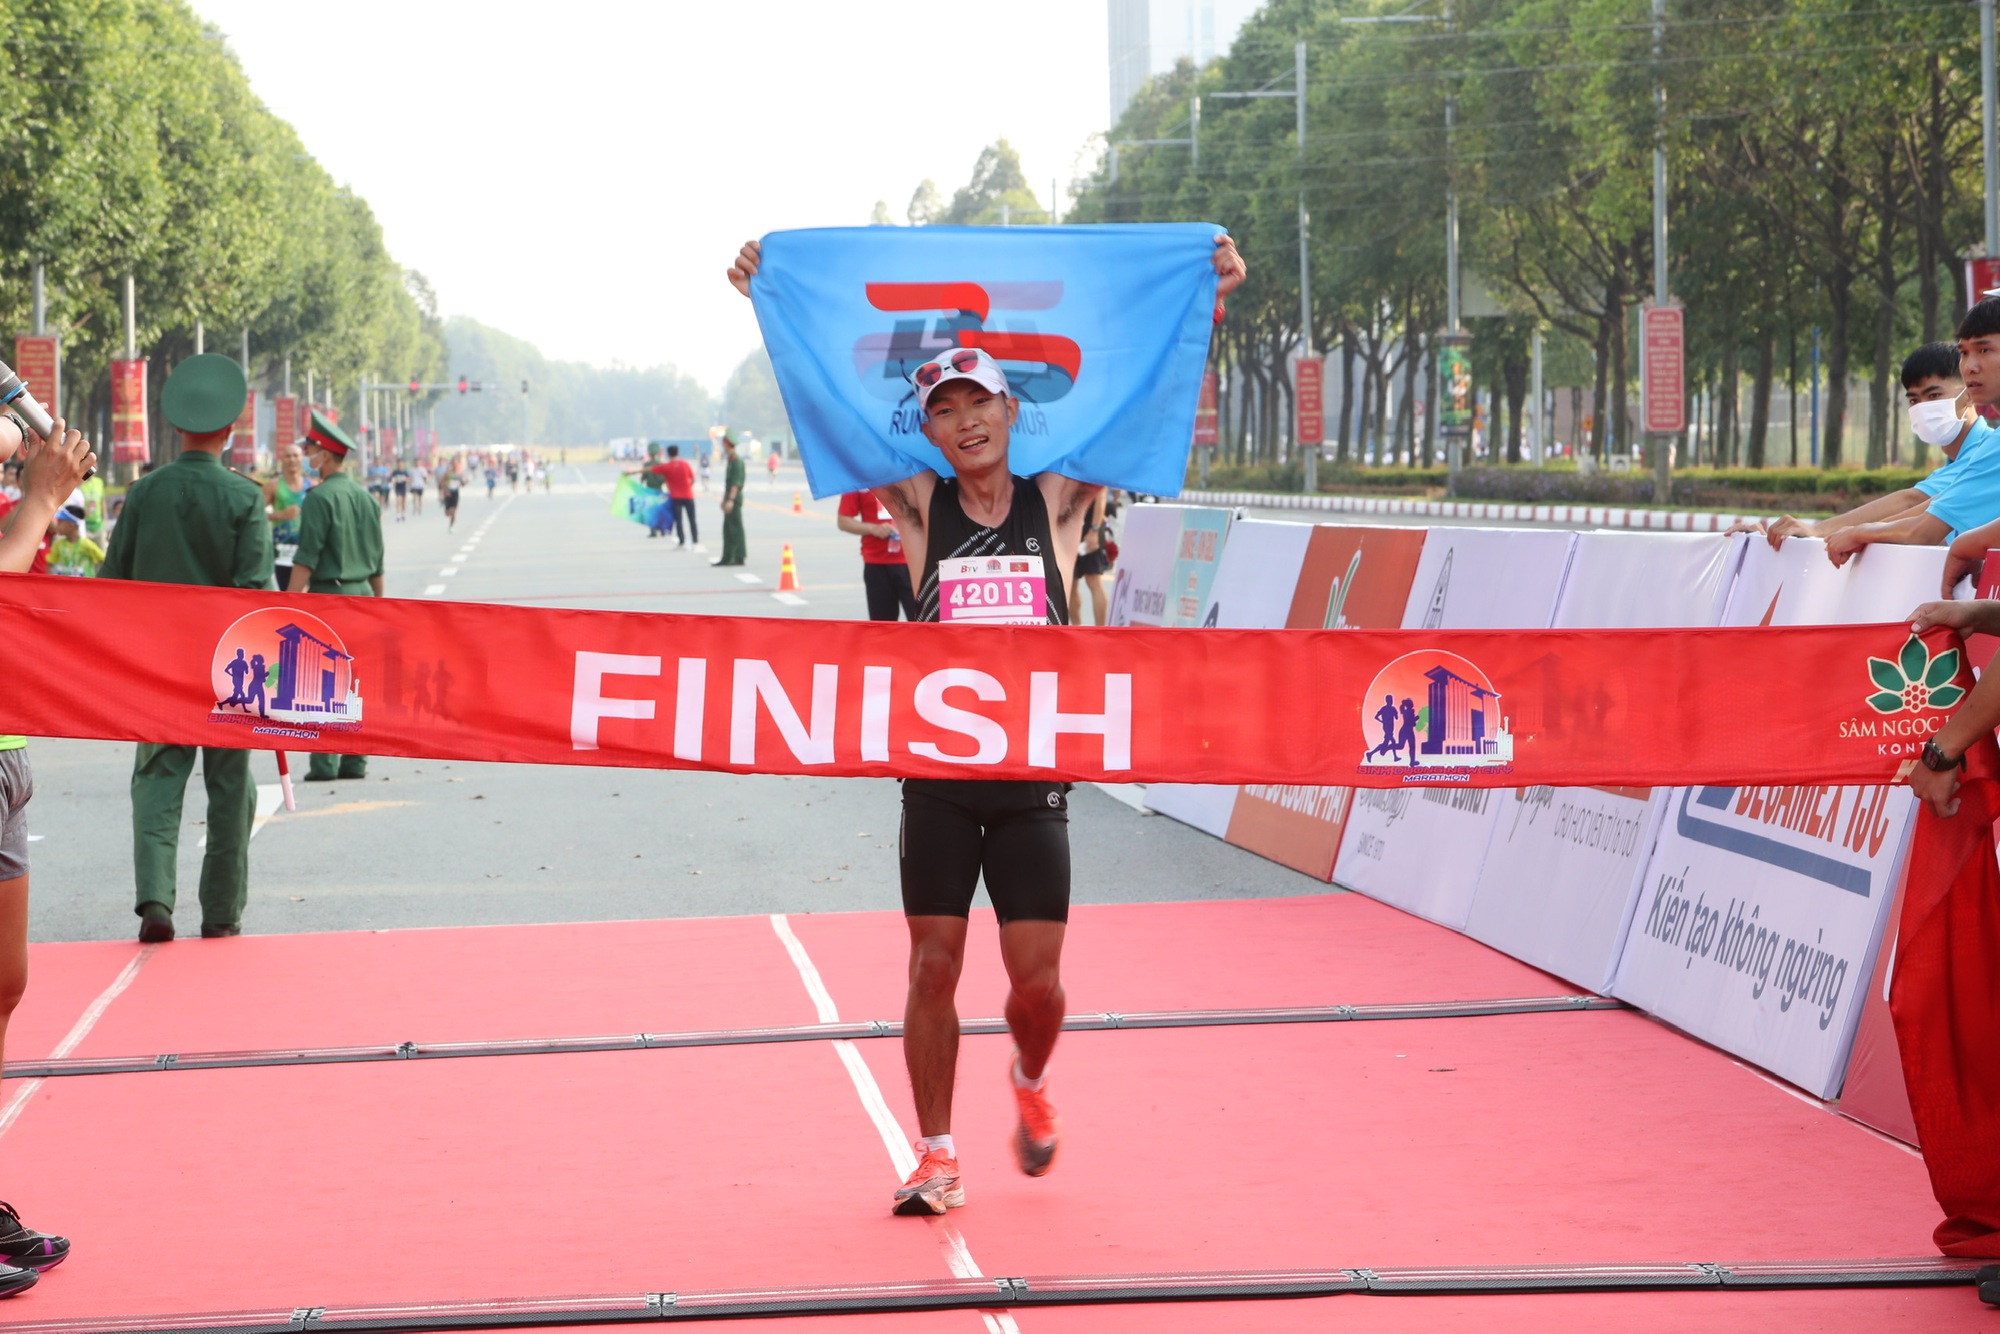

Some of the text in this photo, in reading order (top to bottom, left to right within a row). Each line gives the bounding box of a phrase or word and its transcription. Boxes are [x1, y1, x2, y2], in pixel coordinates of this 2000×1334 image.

[961, 565, 978, 574] BTV
[949, 582, 1034, 607] 42013
[570, 651, 1132, 771] FINISH
[252, 727, 320, 740] MARATHON
[1839, 717, 1878, 739] SÂM
[1882, 715, 1940, 738] NGỌC
[1402, 774, 1471, 783] MARATHON
[1645, 866, 1848, 1031] Kiến tạo không ngừng
